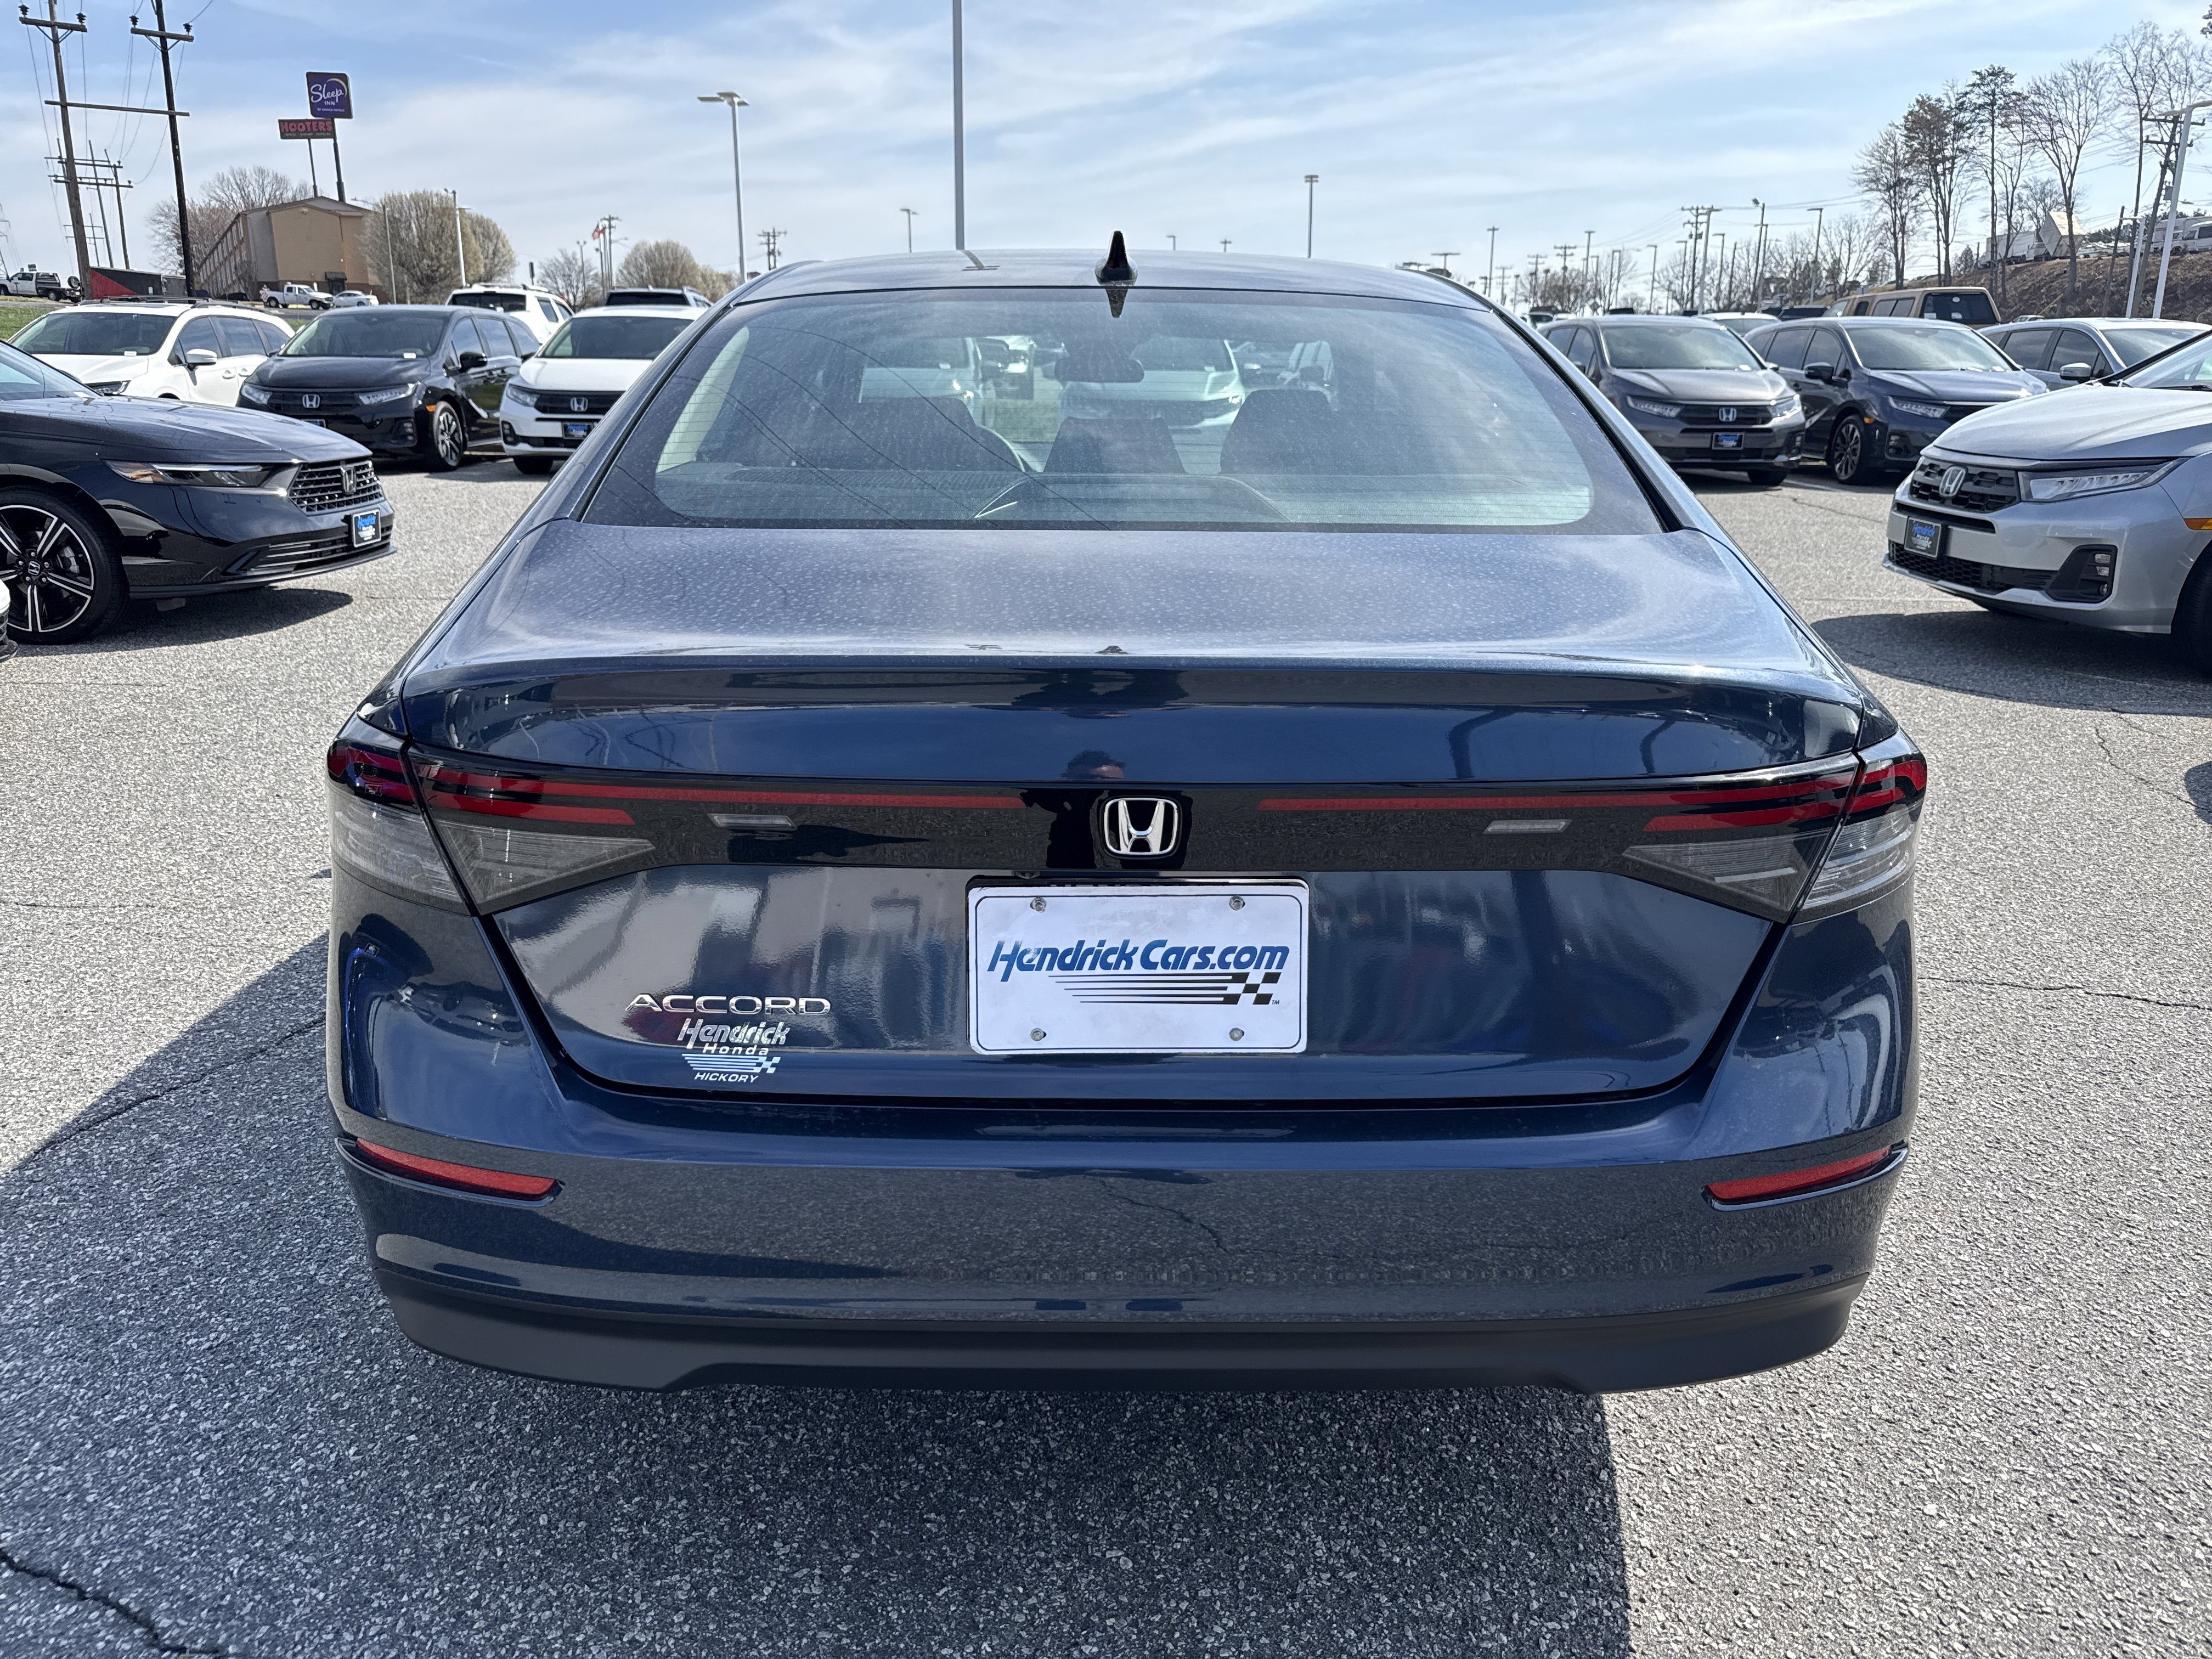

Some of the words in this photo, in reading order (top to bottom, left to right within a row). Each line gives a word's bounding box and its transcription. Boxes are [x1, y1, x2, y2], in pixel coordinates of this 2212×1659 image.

[311, 83, 344, 103] Sleep
[280, 121, 332, 132] HOOTERS
[625, 994, 831, 1015] ACCORD
[677, 1018, 790, 1049] Hendrick
[702, 1042, 769, 1056] Honda
[694, 1072, 759, 1083] HICKORY
